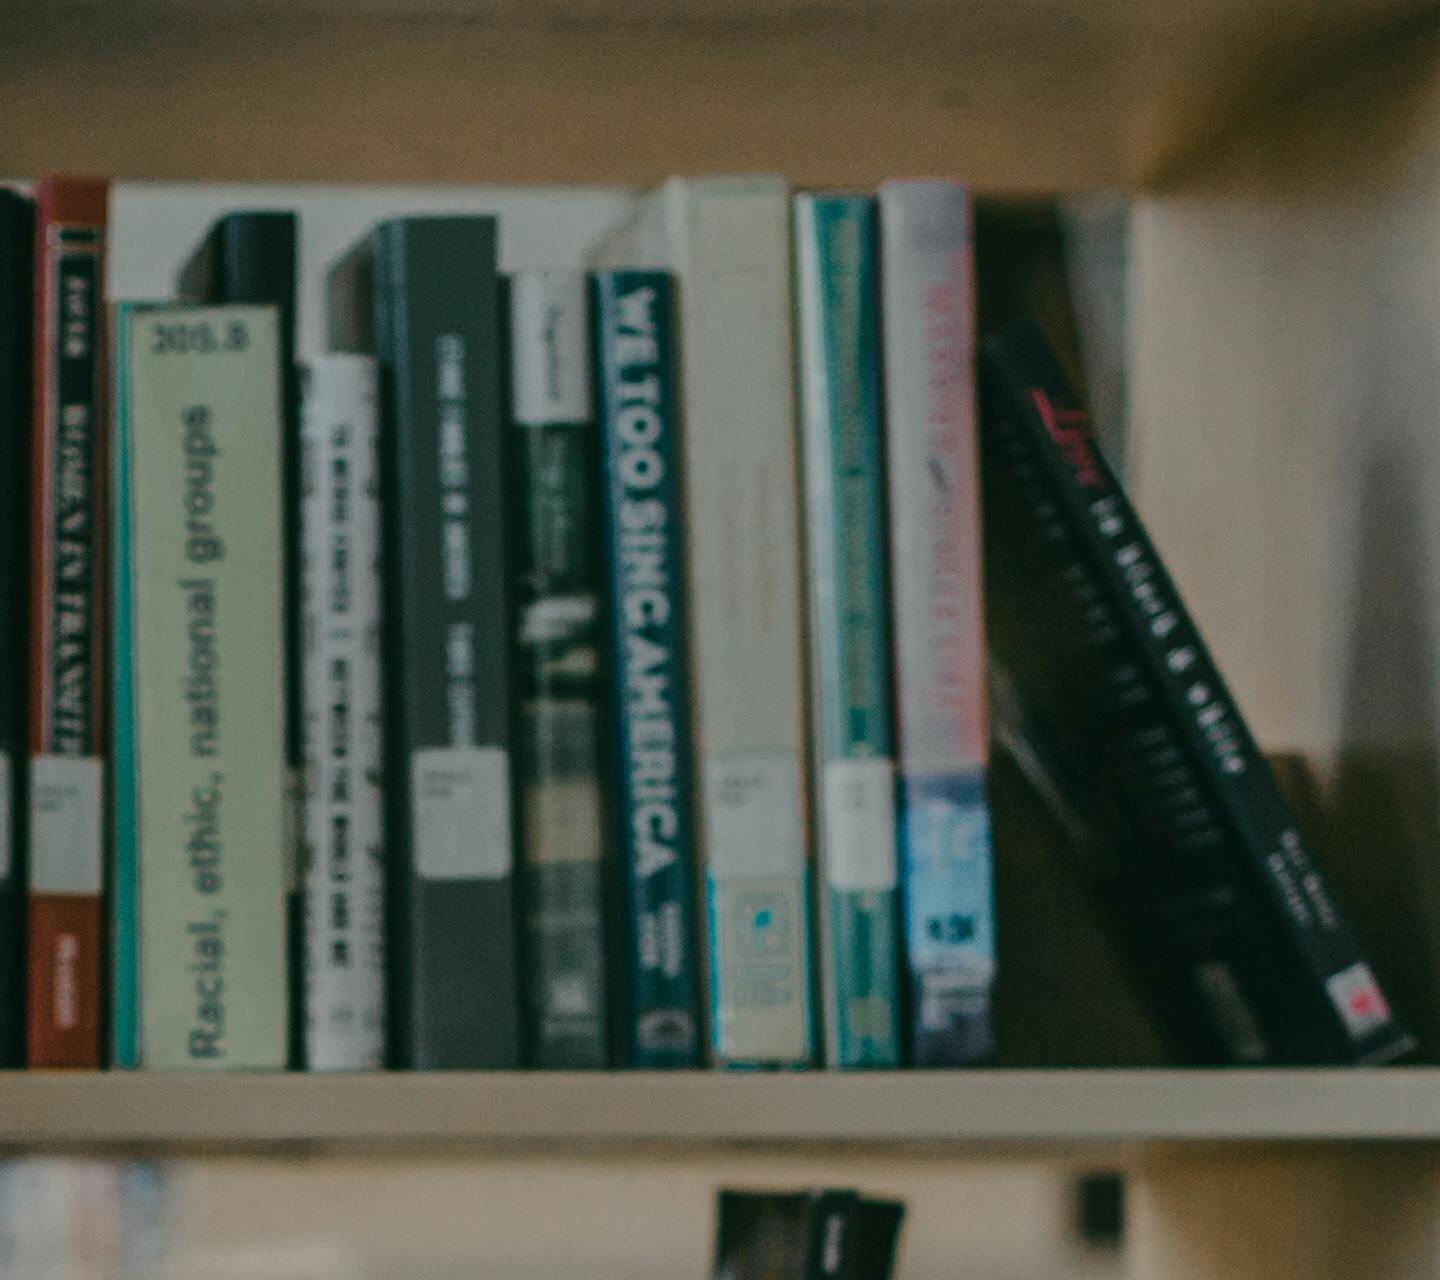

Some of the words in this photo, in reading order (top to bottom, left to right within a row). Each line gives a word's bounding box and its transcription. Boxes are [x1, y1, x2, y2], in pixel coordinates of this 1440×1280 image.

[617, 287, 659, 362] WE
[182, 404, 224, 568] groups
[620, 372, 664, 488] TOO
[622, 499, 670, 634] SING
[178, 578, 218, 758] national
[628, 636, 677, 880] AMERICA
[182, 908, 226, 1062] Racial,
